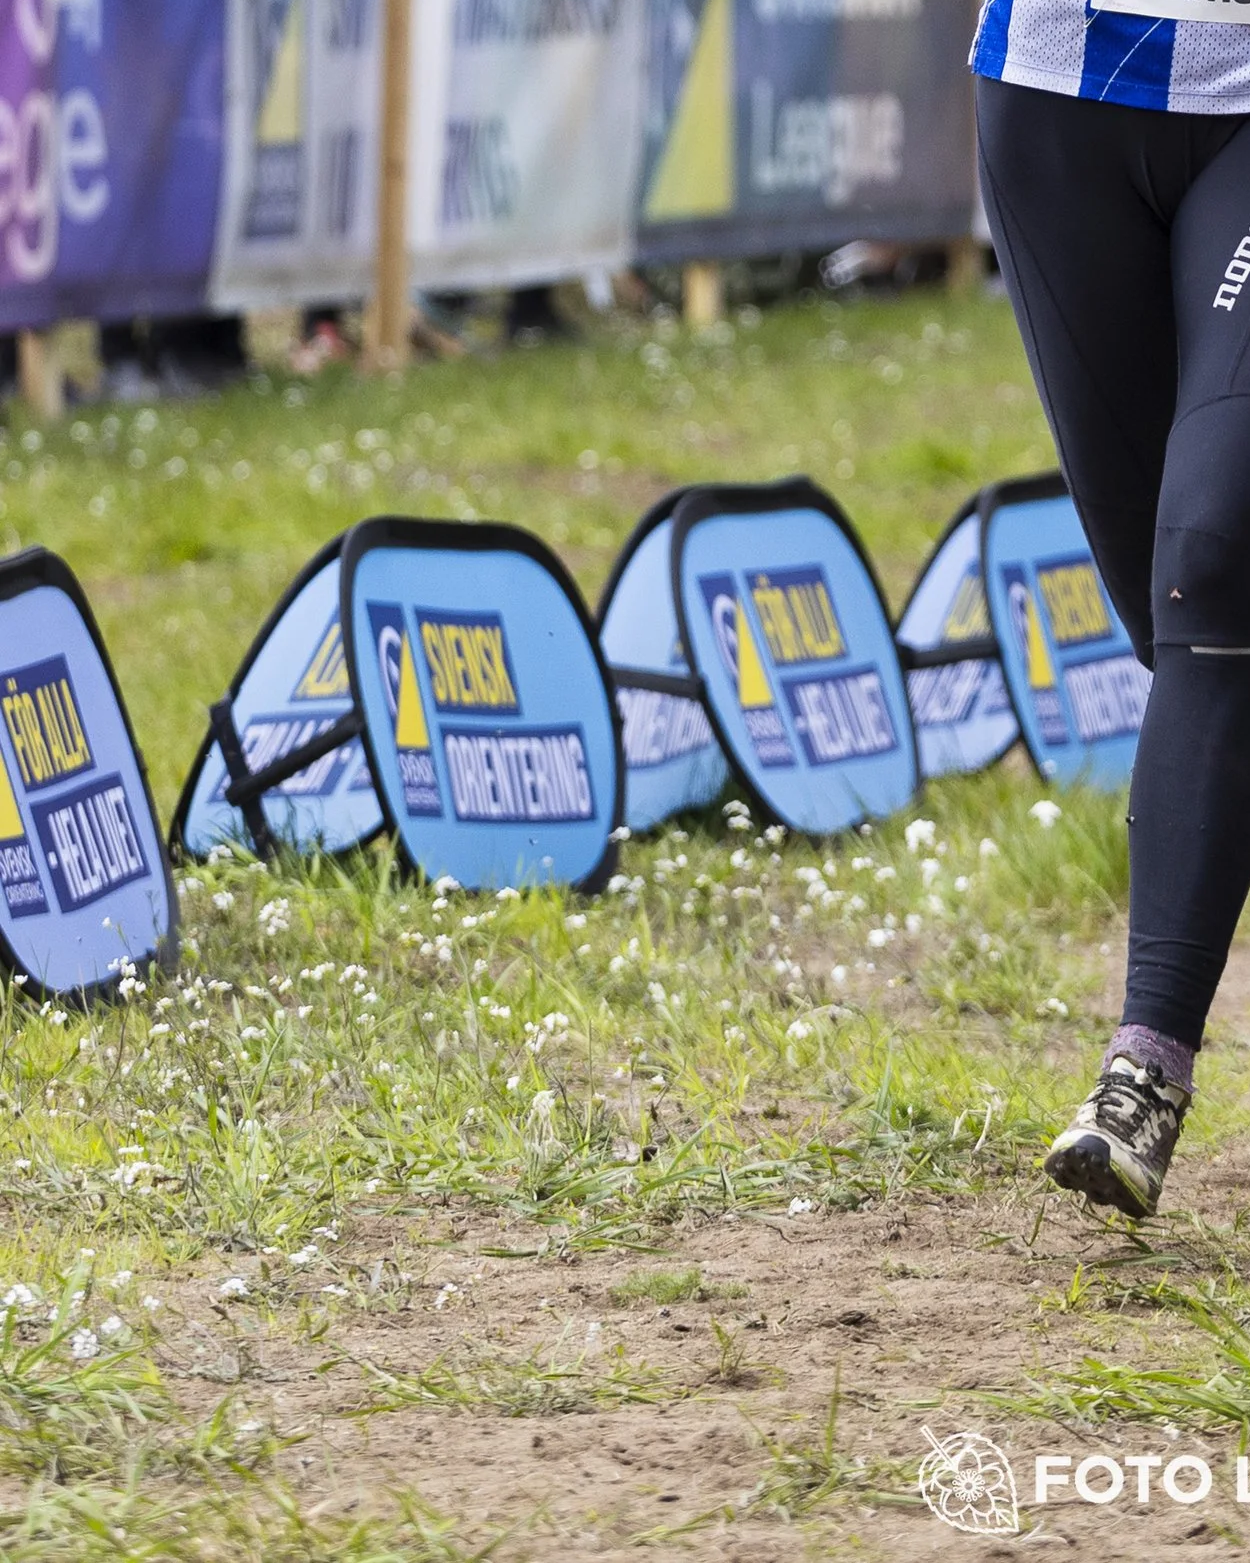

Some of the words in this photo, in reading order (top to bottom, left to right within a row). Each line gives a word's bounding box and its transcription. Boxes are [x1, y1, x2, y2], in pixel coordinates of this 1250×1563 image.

[421, 621, 518, 707] SVENSK
[2, 676, 56, 785] FÖR
[36, 678, 91, 774] ALLA
[444, 733, 595, 819] ORIENTERING
